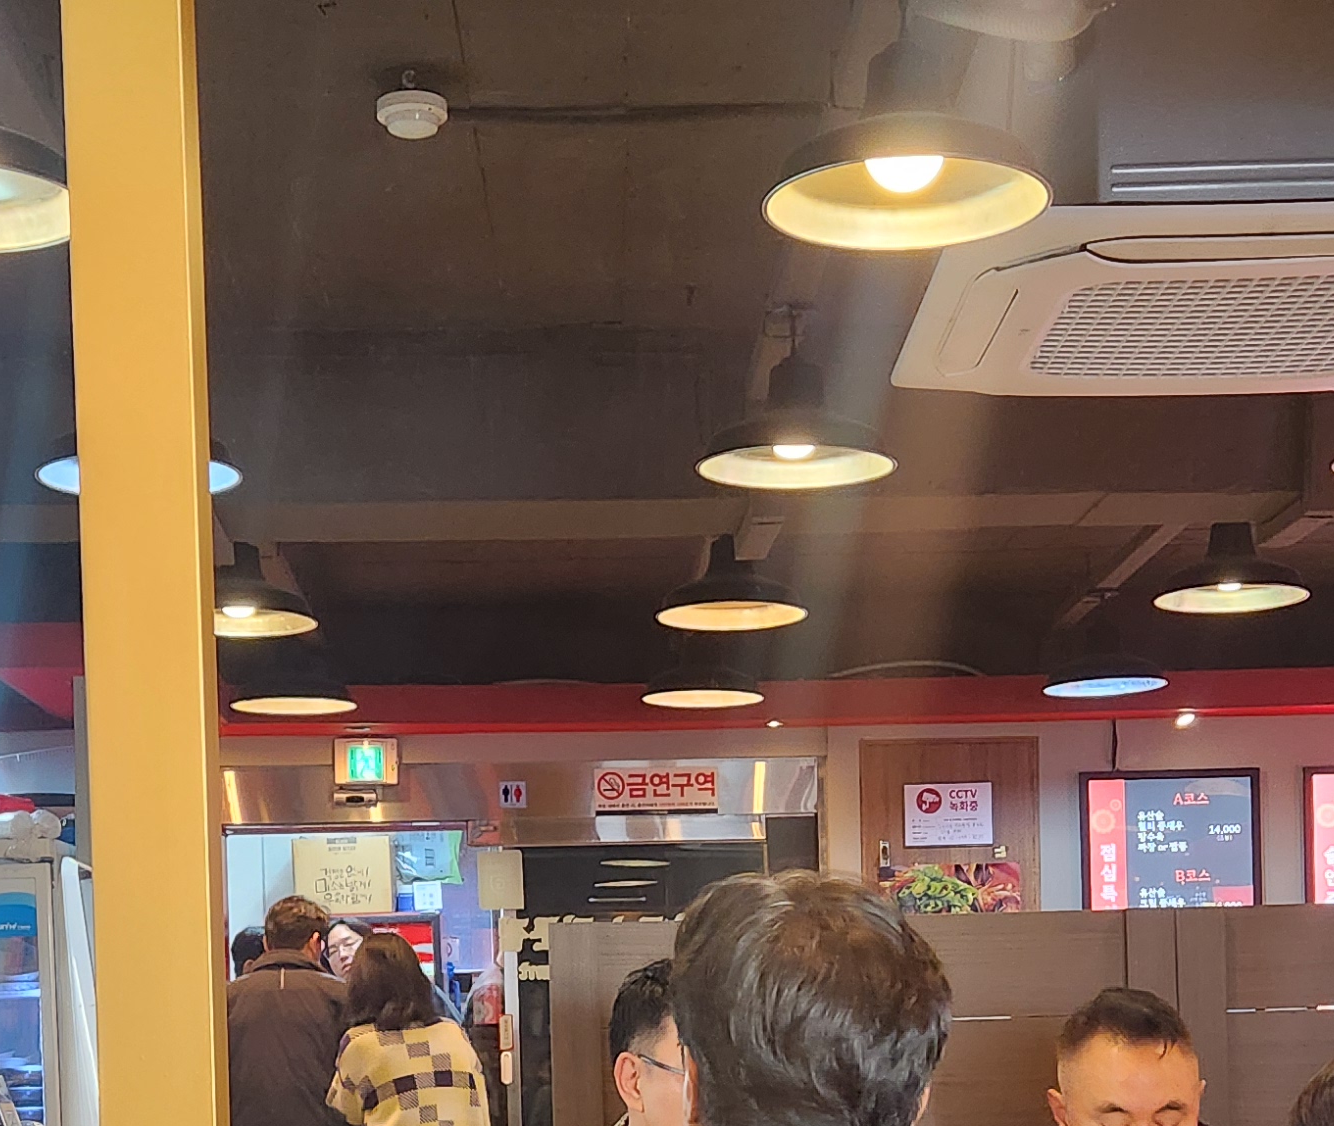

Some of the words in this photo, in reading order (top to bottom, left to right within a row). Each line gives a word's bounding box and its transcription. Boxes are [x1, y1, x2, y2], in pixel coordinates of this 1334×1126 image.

[626, 771, 715, 798] 금연구역
[949, 789, 977, 799] CCTV
[1173, 793, 1209, 805] A코스
[949, 801, 978, 812] 녹화중
[1208, 824, 1242, 835] 14,000
[1157, 843, 1168, 852] or
[1175, 869, 1211, 883] B코스
